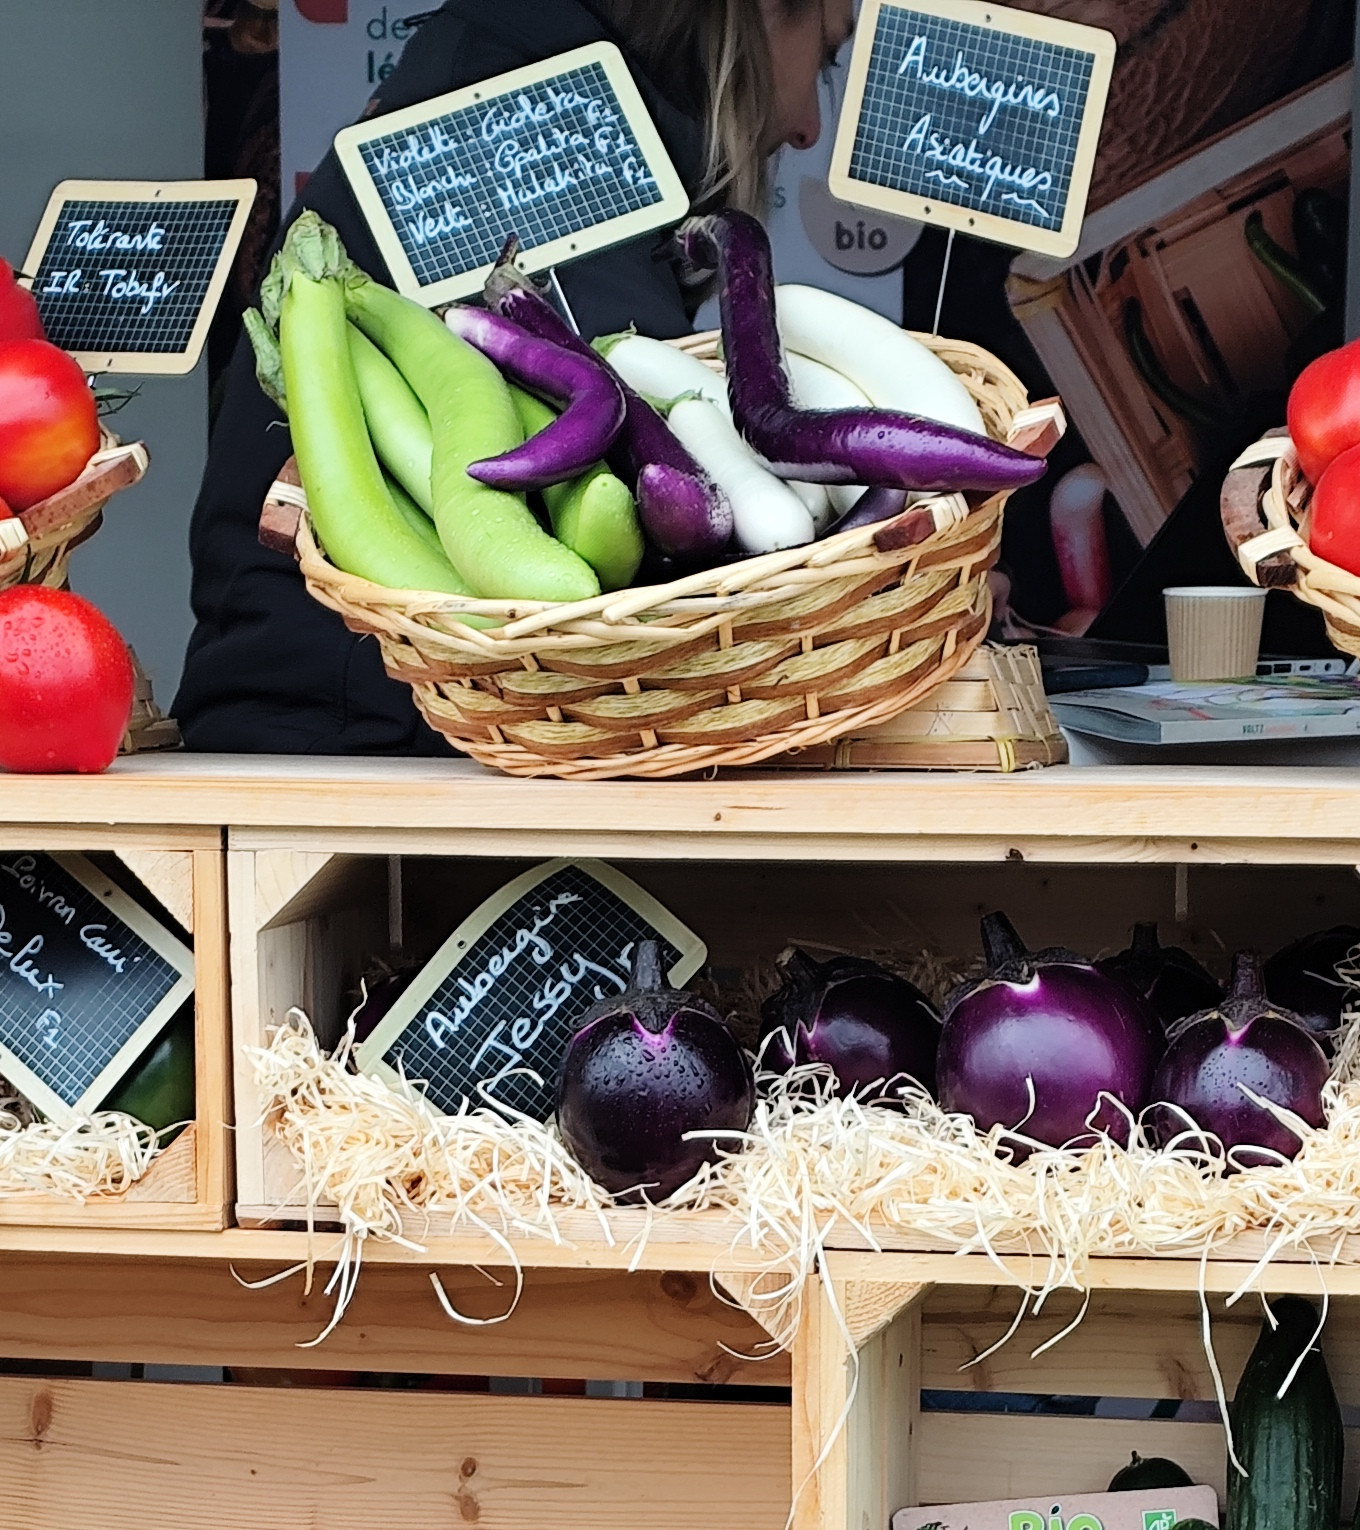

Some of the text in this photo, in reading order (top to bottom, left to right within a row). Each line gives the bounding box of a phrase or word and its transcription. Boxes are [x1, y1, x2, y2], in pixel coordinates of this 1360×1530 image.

[367, 50, 395, 83] lé
[899, 35, 1060, 134] Aubergines
[903, 113, 1052, 201] Asiatiques
[835, 220, 888, 250] bio
